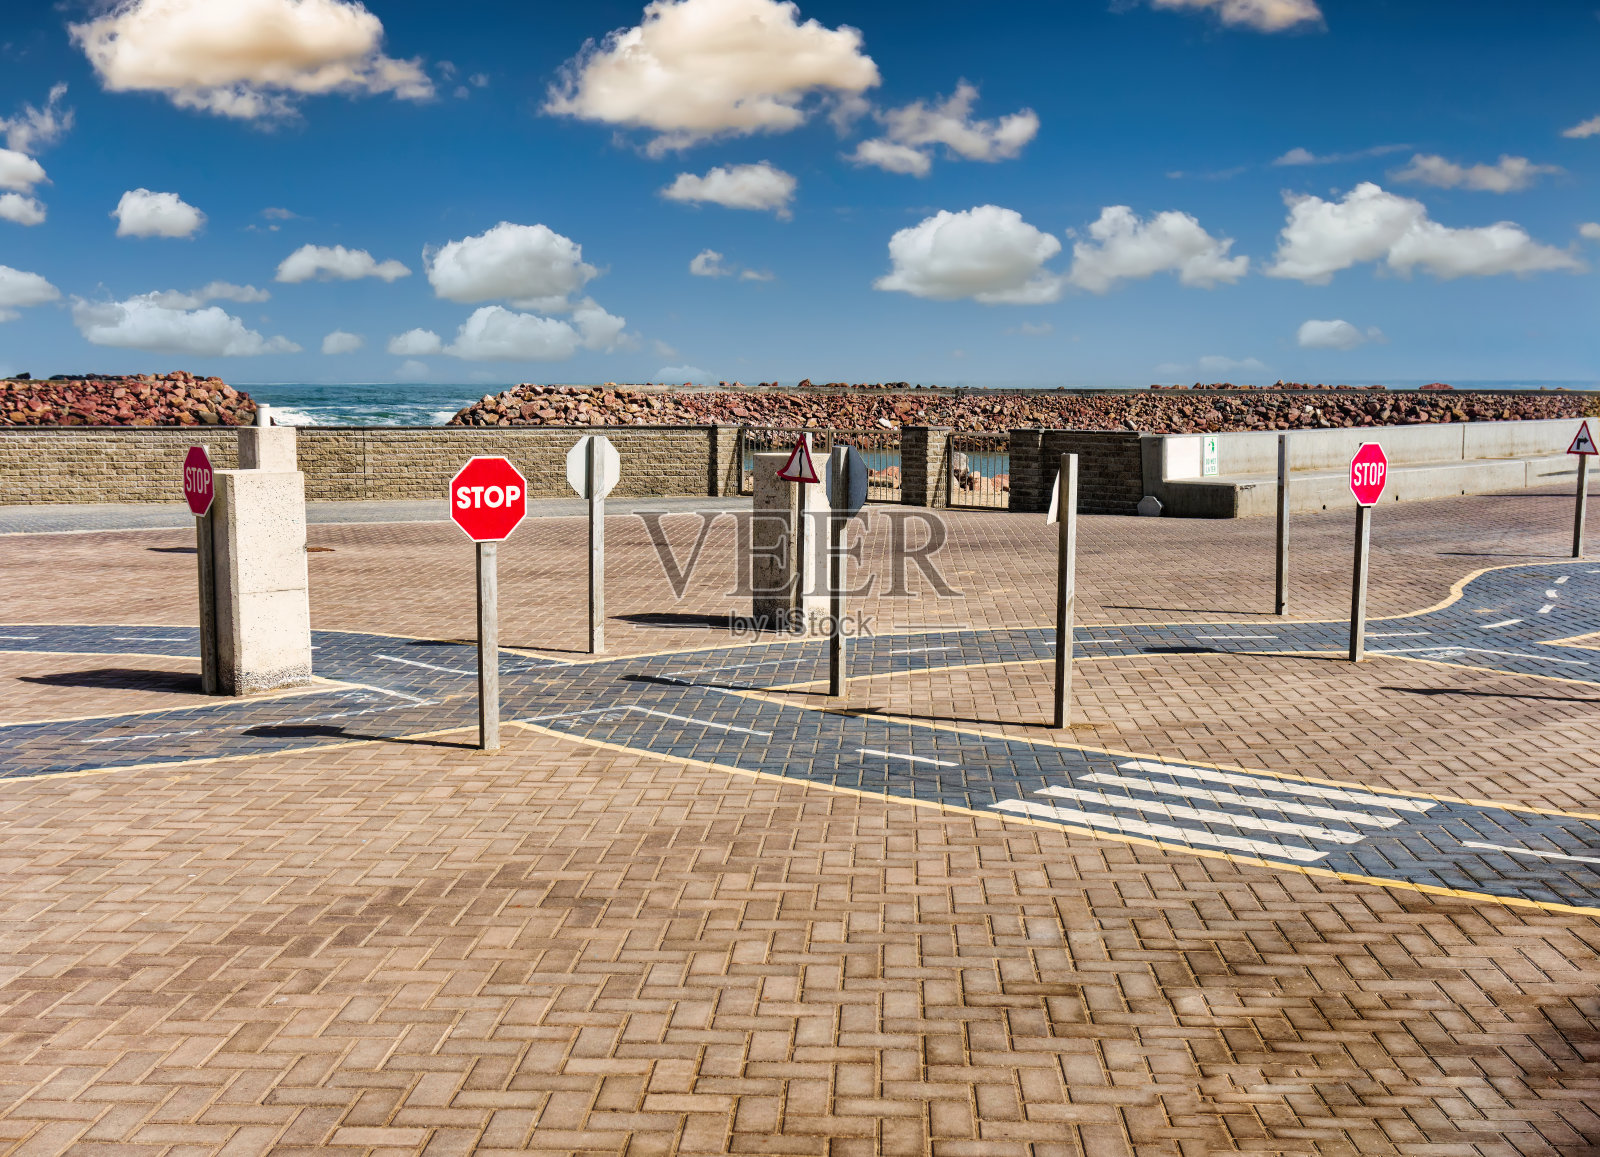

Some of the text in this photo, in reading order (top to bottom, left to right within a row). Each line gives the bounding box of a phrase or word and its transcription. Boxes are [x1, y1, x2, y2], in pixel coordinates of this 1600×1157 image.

[185, 466, 210, 494] STOP
[1353, 462, 1385, 487] STOP
[456, 485, 521, 509] STOP
